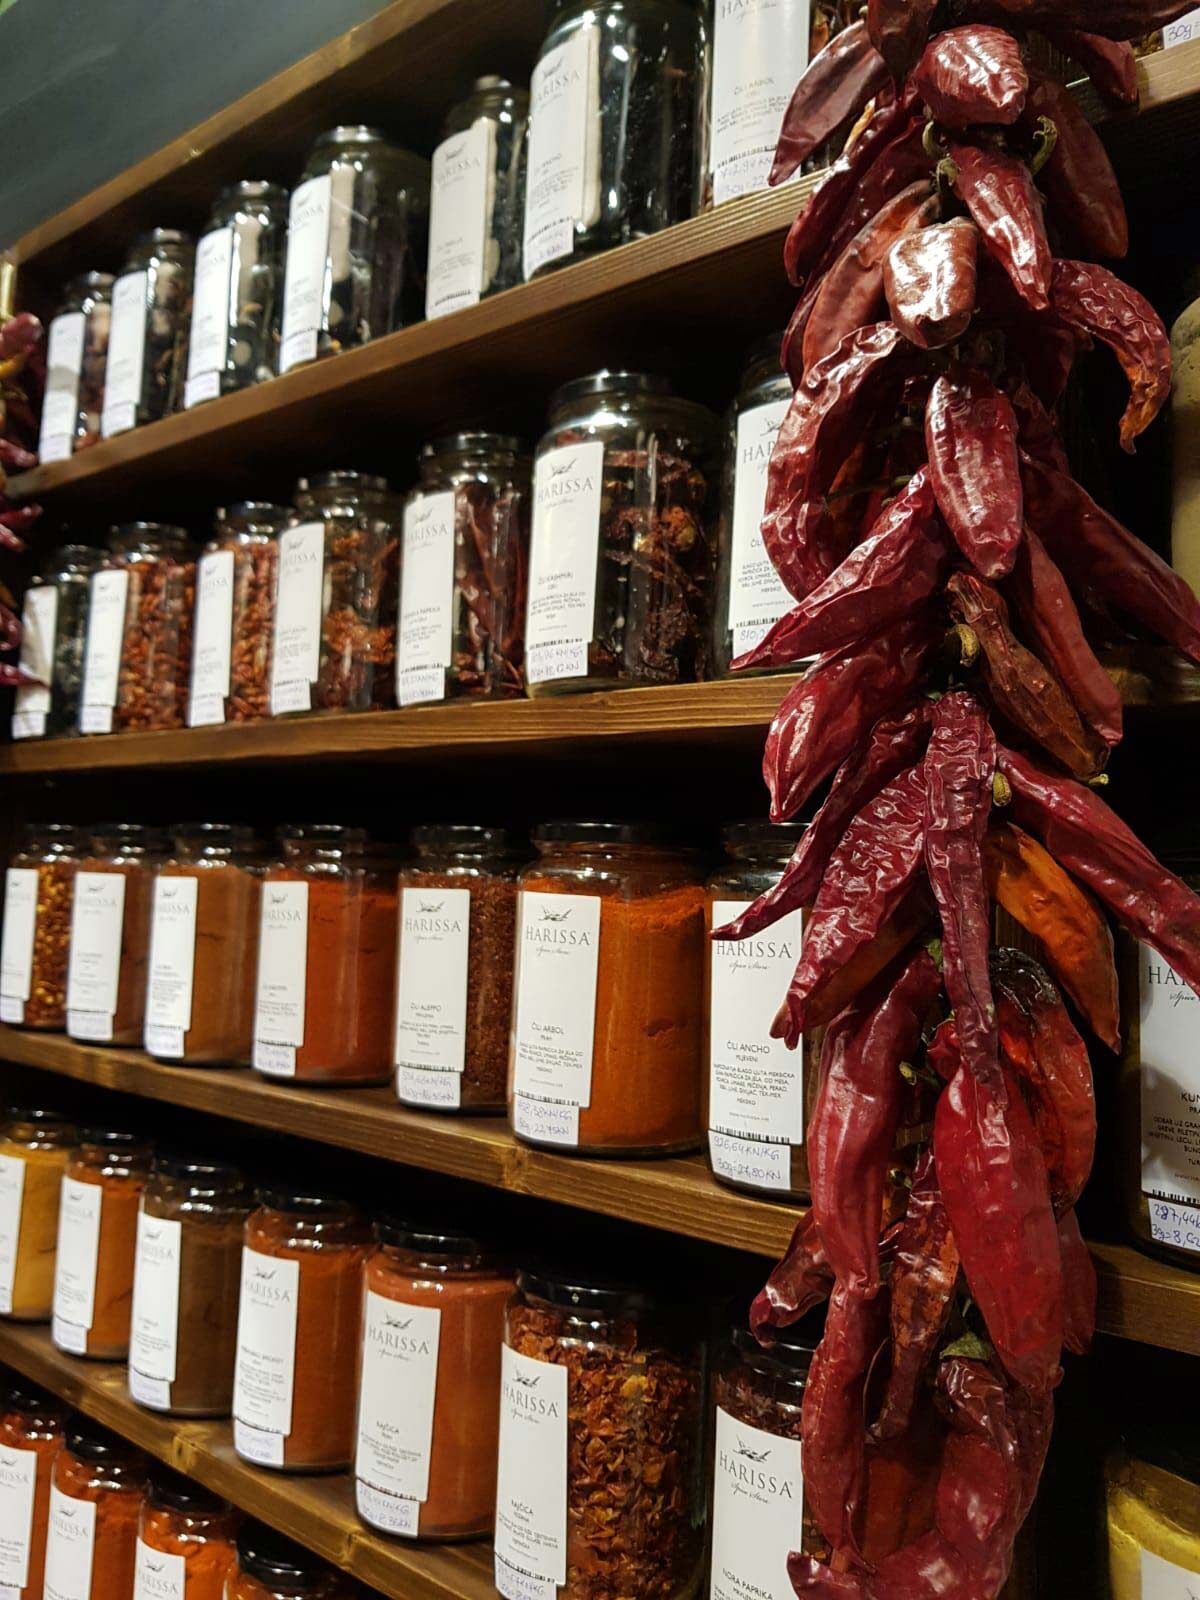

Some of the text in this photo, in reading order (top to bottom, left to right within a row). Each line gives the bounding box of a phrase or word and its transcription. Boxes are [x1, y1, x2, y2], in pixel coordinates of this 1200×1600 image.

[405, 918, 462, 933] HARISSA
[526, 925, 592, 946] HARISSA
[716, 940, 793, 959] HARISSA
[739, 1043, 770, 1054] ANCHO
[368, 1323, 430, 1355] HARISSA
[503, 1380, 559, 1418] HARISSA
[719, 1449, 792, 1499] HARISSA
